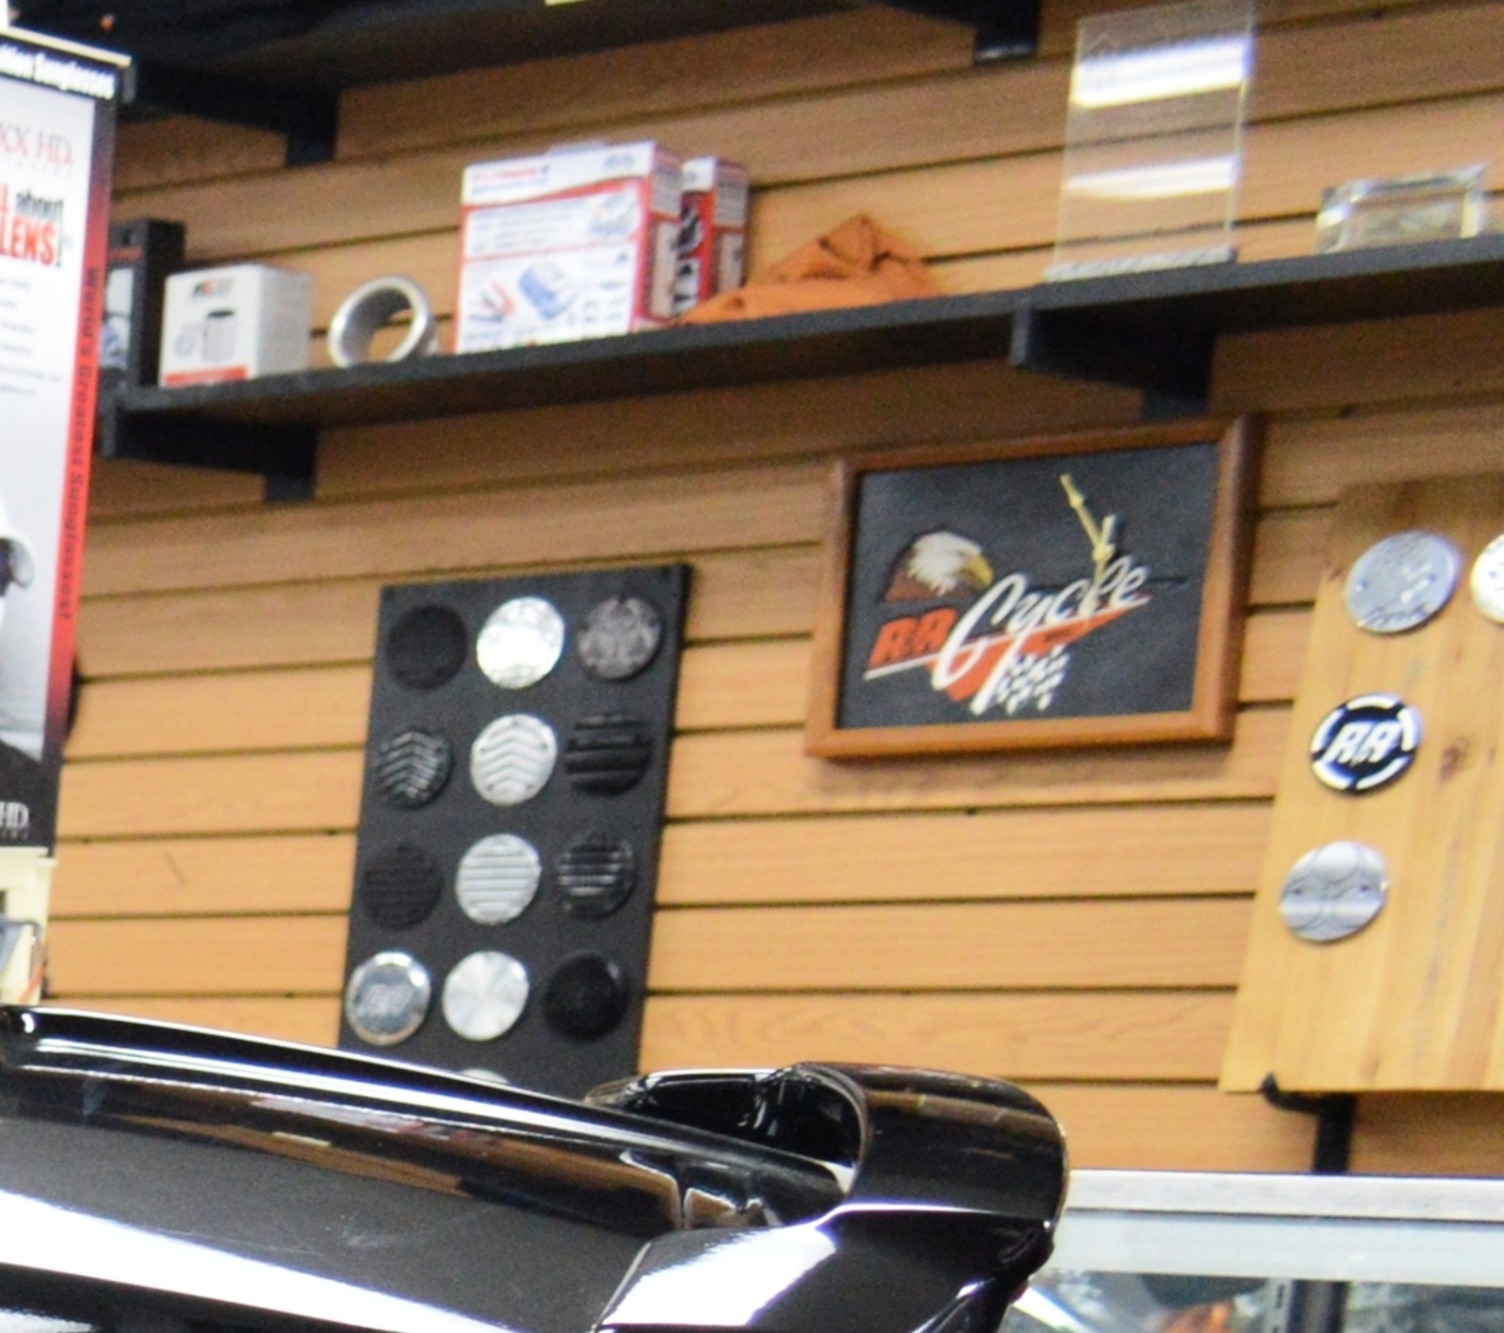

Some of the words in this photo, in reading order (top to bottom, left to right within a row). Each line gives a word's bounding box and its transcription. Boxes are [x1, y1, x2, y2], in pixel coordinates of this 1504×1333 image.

[33, 52, 116, 100] Sunglasses
[14, 188, 64, 222] about
[931, 555, 1150, 716] Cycle
